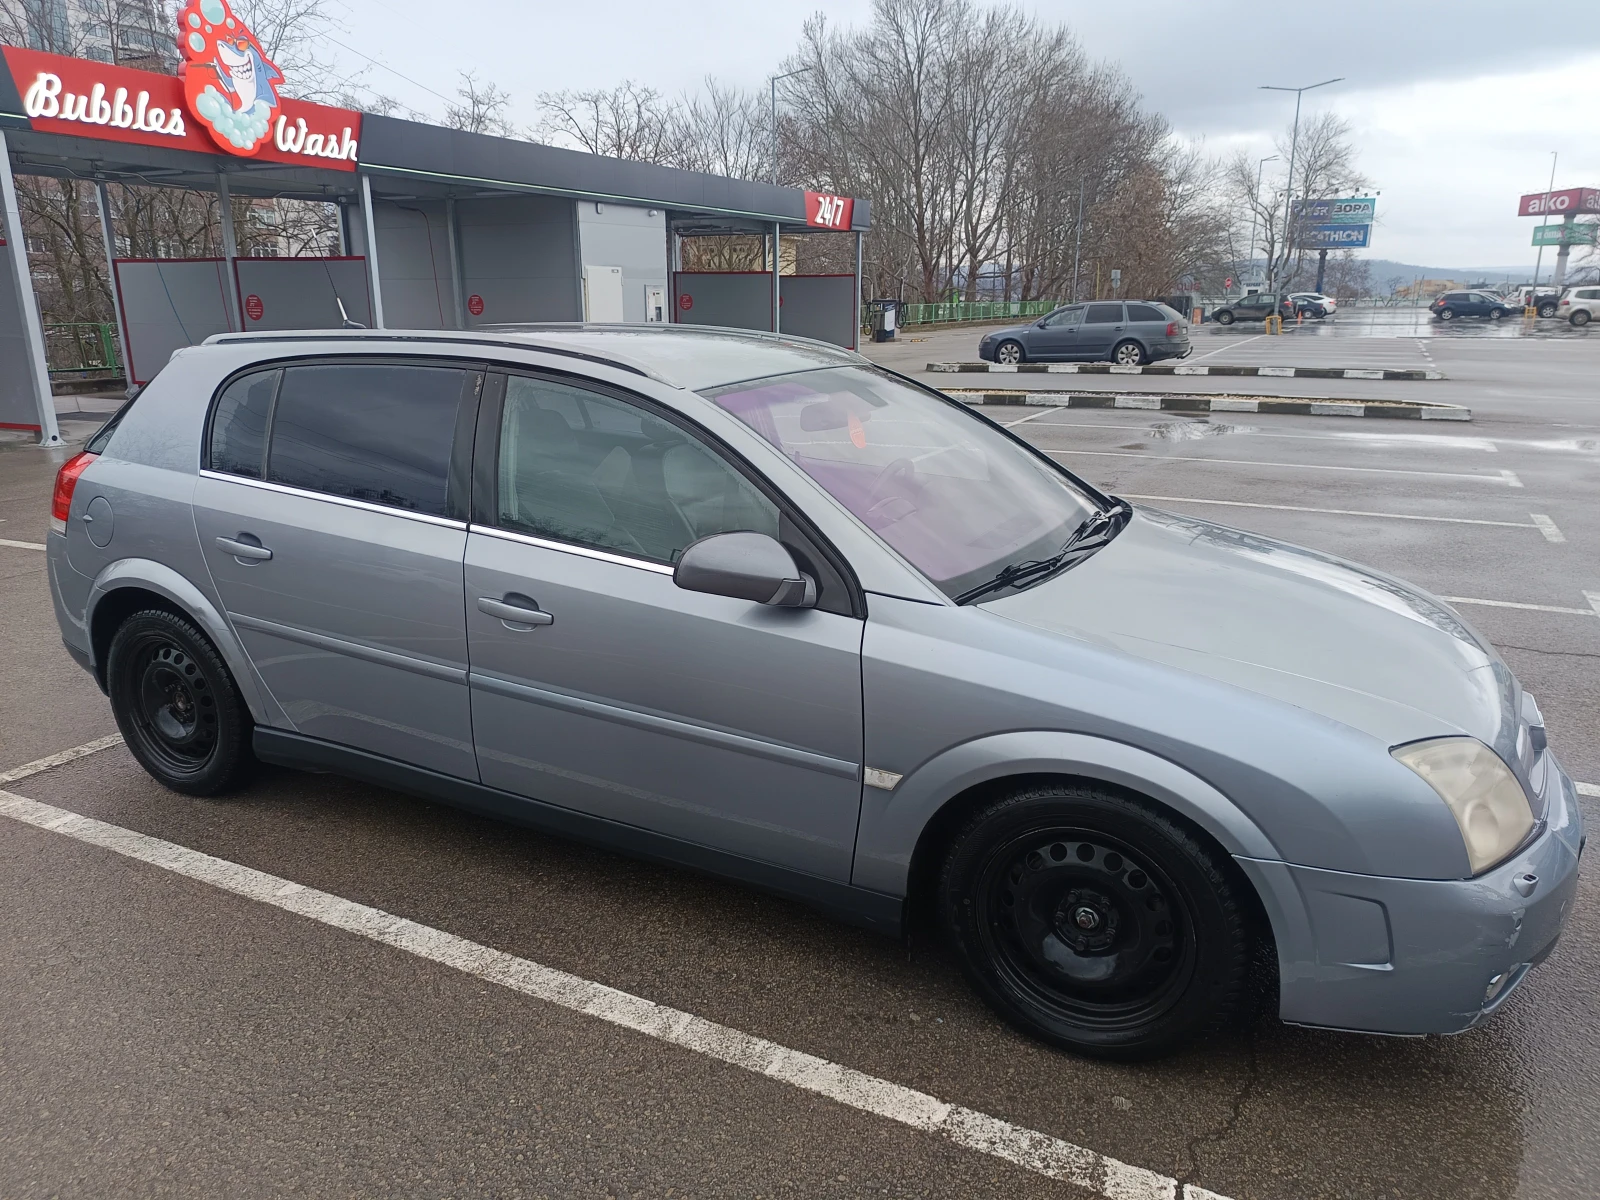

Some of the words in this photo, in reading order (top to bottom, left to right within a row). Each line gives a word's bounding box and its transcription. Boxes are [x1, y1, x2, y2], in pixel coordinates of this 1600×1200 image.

[24, 72, 187, 137] Bubbles
[275, 115, 358, 161] Wash
[815, 196, 845, 227] 24/7
[1528, 194, 1570, 213] aiko
